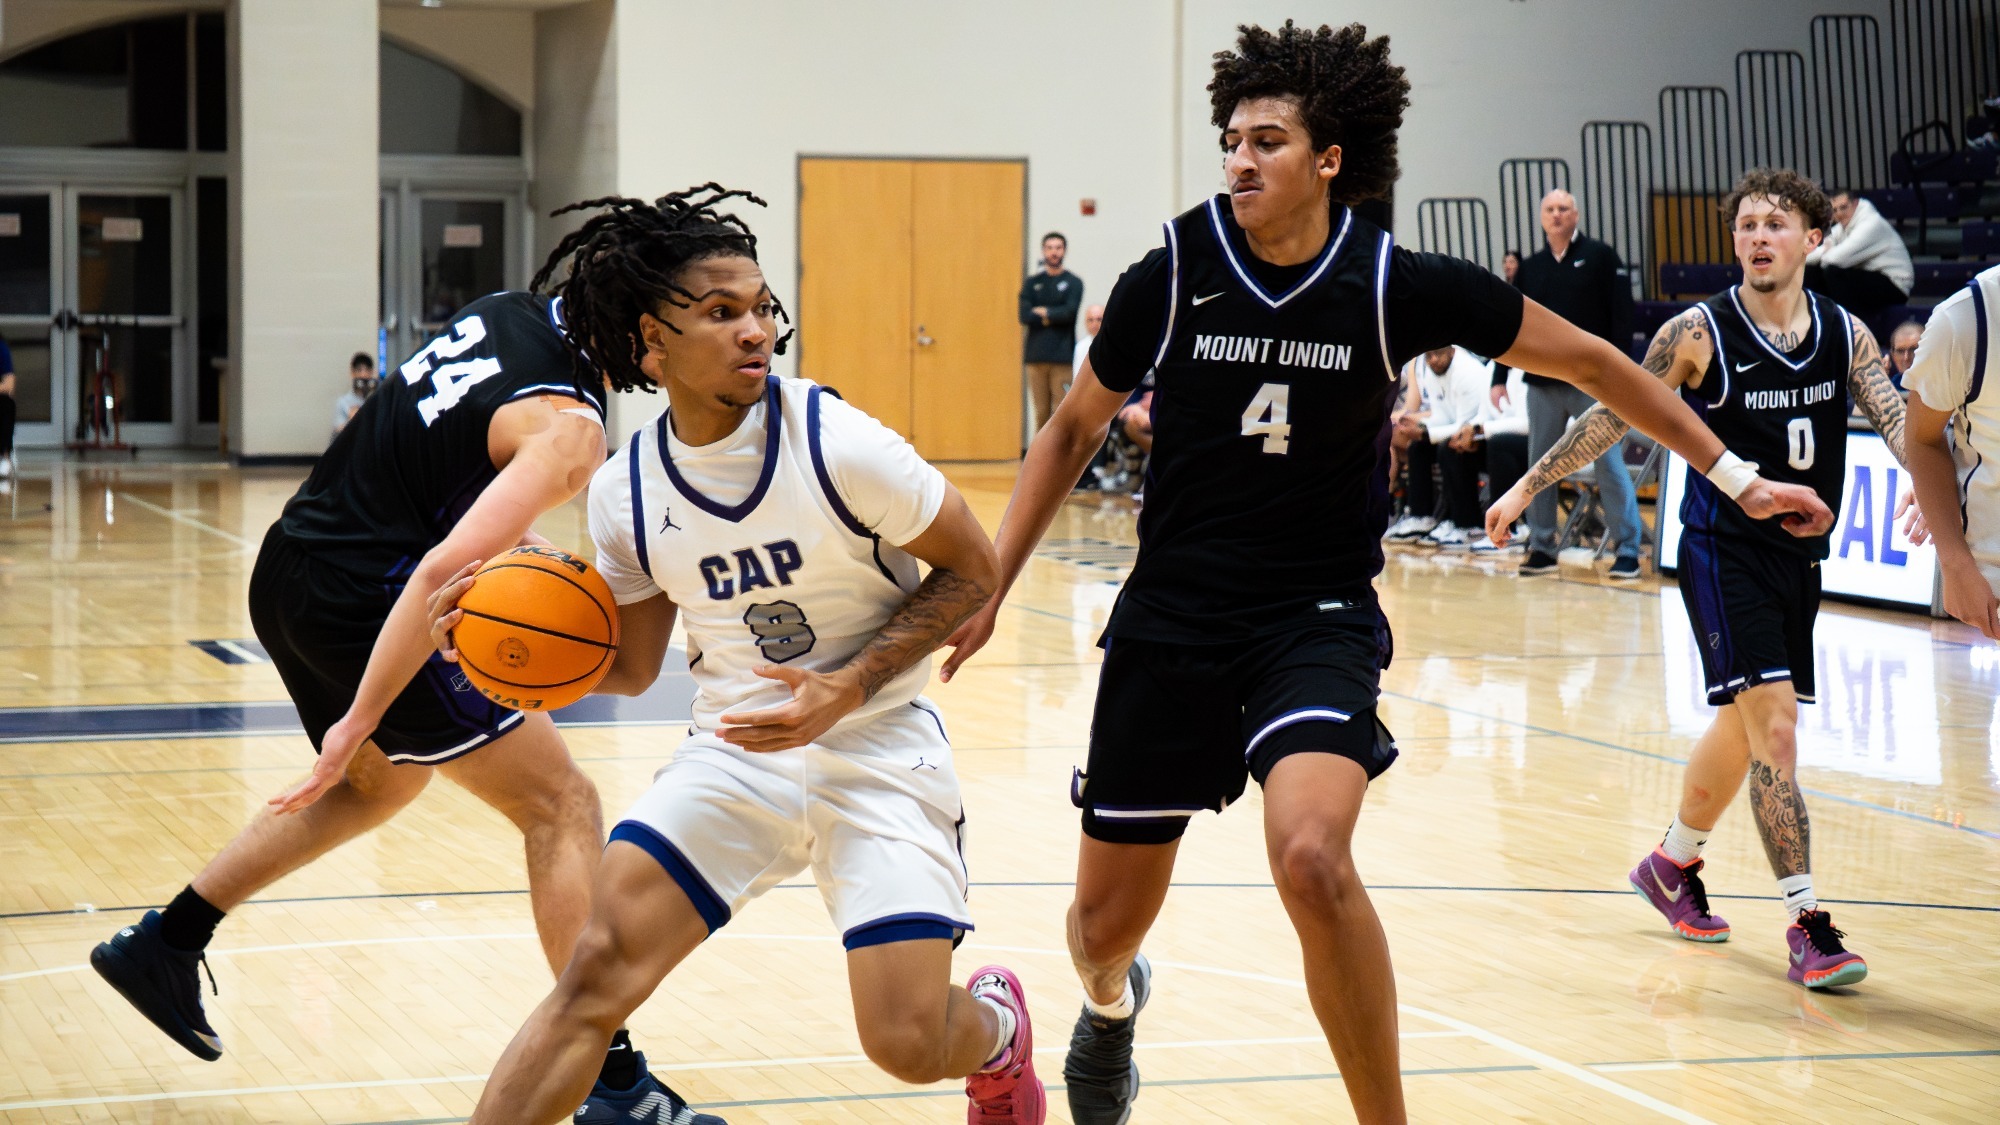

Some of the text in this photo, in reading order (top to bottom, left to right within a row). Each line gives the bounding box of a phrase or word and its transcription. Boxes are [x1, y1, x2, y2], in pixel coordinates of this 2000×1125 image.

[399, 315, 502, 428] 24
[1193, 334, 1352, 371] MOUNT UNION
[1240, 382, 1292, 455] 4
[1744, 389, 1799, 410] MOUNT
[1787, 417, 1815, 471] 0
[698, 537, 804, 600] CAP
[742, 600, 816, 664] 8
